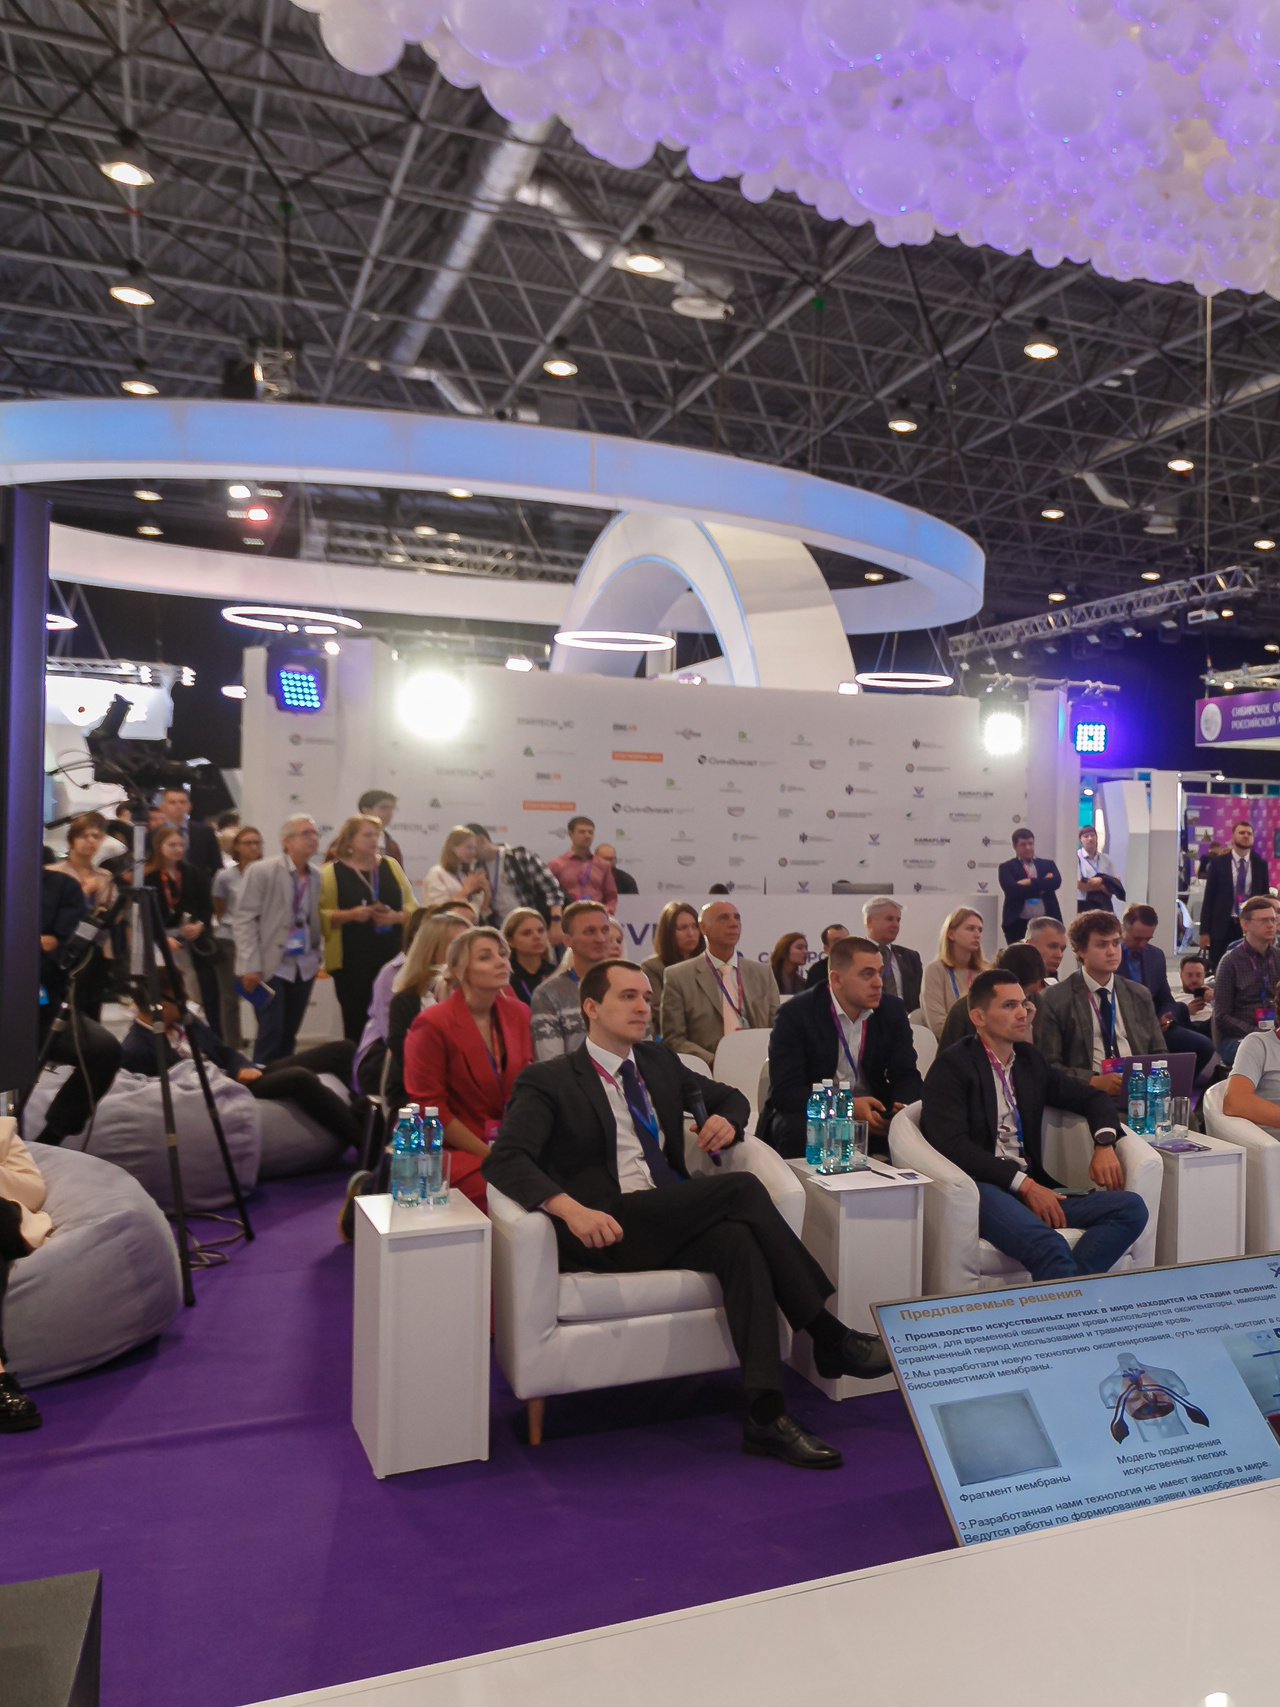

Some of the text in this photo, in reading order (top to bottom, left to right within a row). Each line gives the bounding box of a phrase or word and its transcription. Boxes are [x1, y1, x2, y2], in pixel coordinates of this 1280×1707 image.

[1231, 701, 1270, 717] СИБИРСКОЕ
[1231, 715, 1276, 730] РОССИЙСКОЙ
[899, 1289, 1084, 1322] Предлагаемые решения
[904, 1325, 984, 1342] Производство
[985, 1312, 1064, 1332] искусственных
[1066, 1307, 1099, 1320] легких
[1109, 1303, 1135, 1313] мире
[1136, 1295, 1185, 1309] находится
[1186, 1294, 1199, 1302] на
[1199, 1289, 1232, 1300] стадии
[1233, 1283, 1278, 1295] освоения.
[943, 1338, 963, 1349] для
[964, 1328, 1020, 1346] временной
[1020, 1320, 1081, 1337] оксигенации
[1081, 1317, 1109, 1328] крови
[1110, 1307, 1173, 1324] используются
[1236, 1292, 1277, 1305] имеющие
[898, 1347, 972, 1367] ограниченный
[973, 1342, 1012, 1356] период
[1012, 1331, 1085, 1350] использования
[1086, 1330, 1094, 1338] и
[932, 1358, 1000, 1378] разработали
[1000, 1353, 1033, 1366] новую
[1033, 1344, 1091, 1361] технологию
[1174, 1328, 1195, 1340] суть
[1234, 1317, 1267, 1329] состоит
[1267, 1316, 1275, 1324] в
[906, 1362, 1054, 1392] биосовместимой мембраны.
[1116, 1437, 1223, 1466] Модель подключения
[1122, 1447, 1229, 1477] искусственных легких
[959, 1474, 1072, 1503] Фрагмент мембраны
[1054, 1497, 1084, 1512] нами
[1083, 1485, 1144, 1506] технология
[1143, 1482, 1158, 1493] не
[1158, 1475, 1189, 1490] имеет
[1190, 1465, 1236, 1483] аналогов
[1235, 1464, 1244, 1474] в
[963, 1526, 1012, 1545] Ведутся
[1011, 1518, 1055, 1537] работы
[1055, 1514, 1070, 1526] по
[1070, 1496, 1152, 1523] формированию
[1151, 1488, 1188, 1505] заявки
[1188, 1484, 1202, 1496] на
